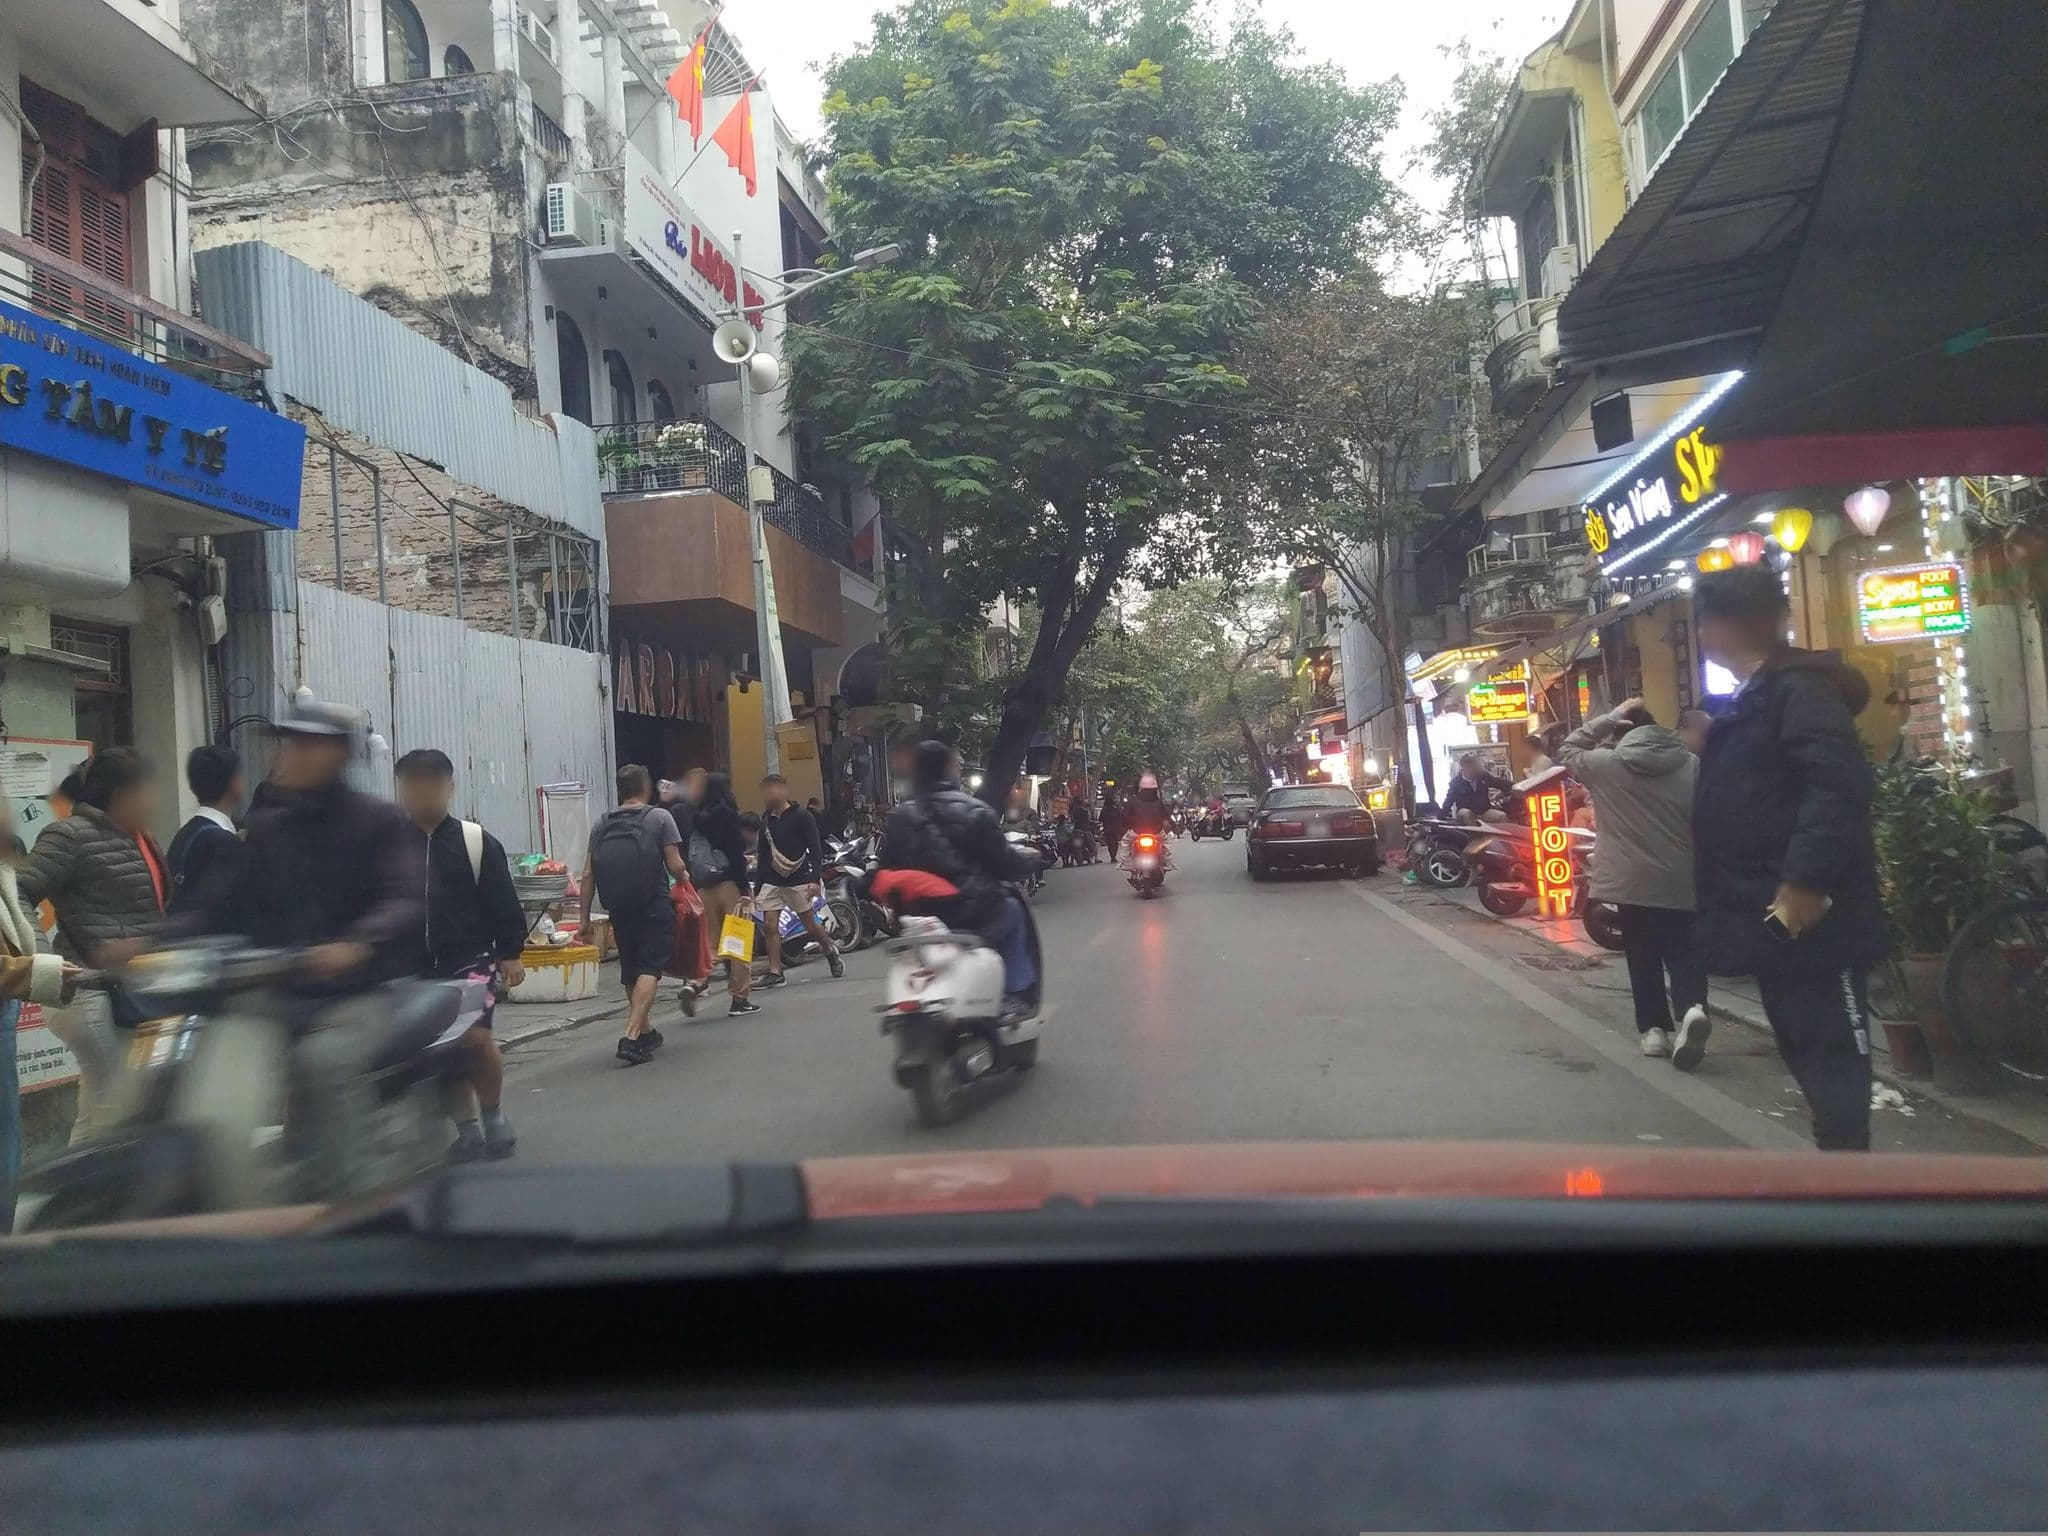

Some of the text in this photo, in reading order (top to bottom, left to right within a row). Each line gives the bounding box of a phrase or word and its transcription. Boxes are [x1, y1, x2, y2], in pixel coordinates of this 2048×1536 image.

[40, 377, 134, 445] TÂM
[143, 413, 171, 456] Y
[1919, 570, 1950, 583] FOOT
[1924, 600, 1956, 613] BODY
[1540, 795, 1572, 916] FOOT
